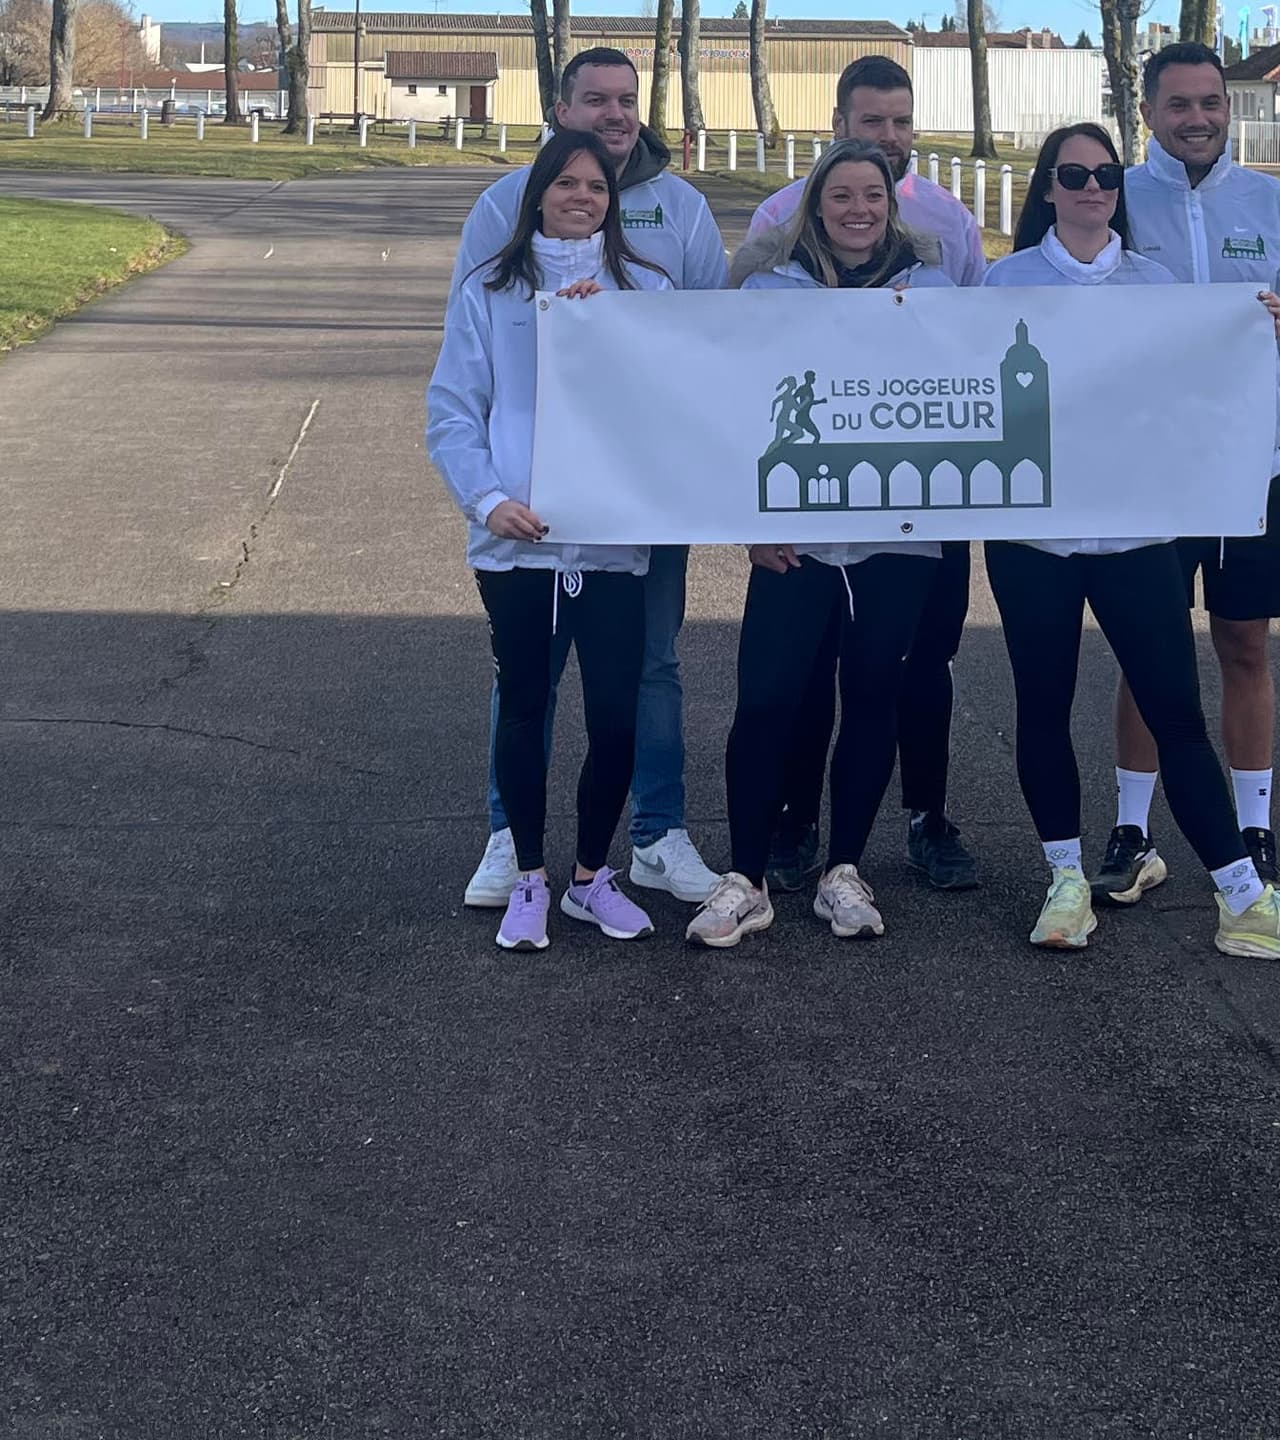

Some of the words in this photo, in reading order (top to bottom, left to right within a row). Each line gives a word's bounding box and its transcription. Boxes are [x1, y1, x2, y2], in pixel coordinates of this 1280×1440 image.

[830, 379, 870, 397] LES
[877, 377, 995, 396] JOGGEURS
[832, 412, 862, 431] DU
[869, 400, 996, 430] COEUR
